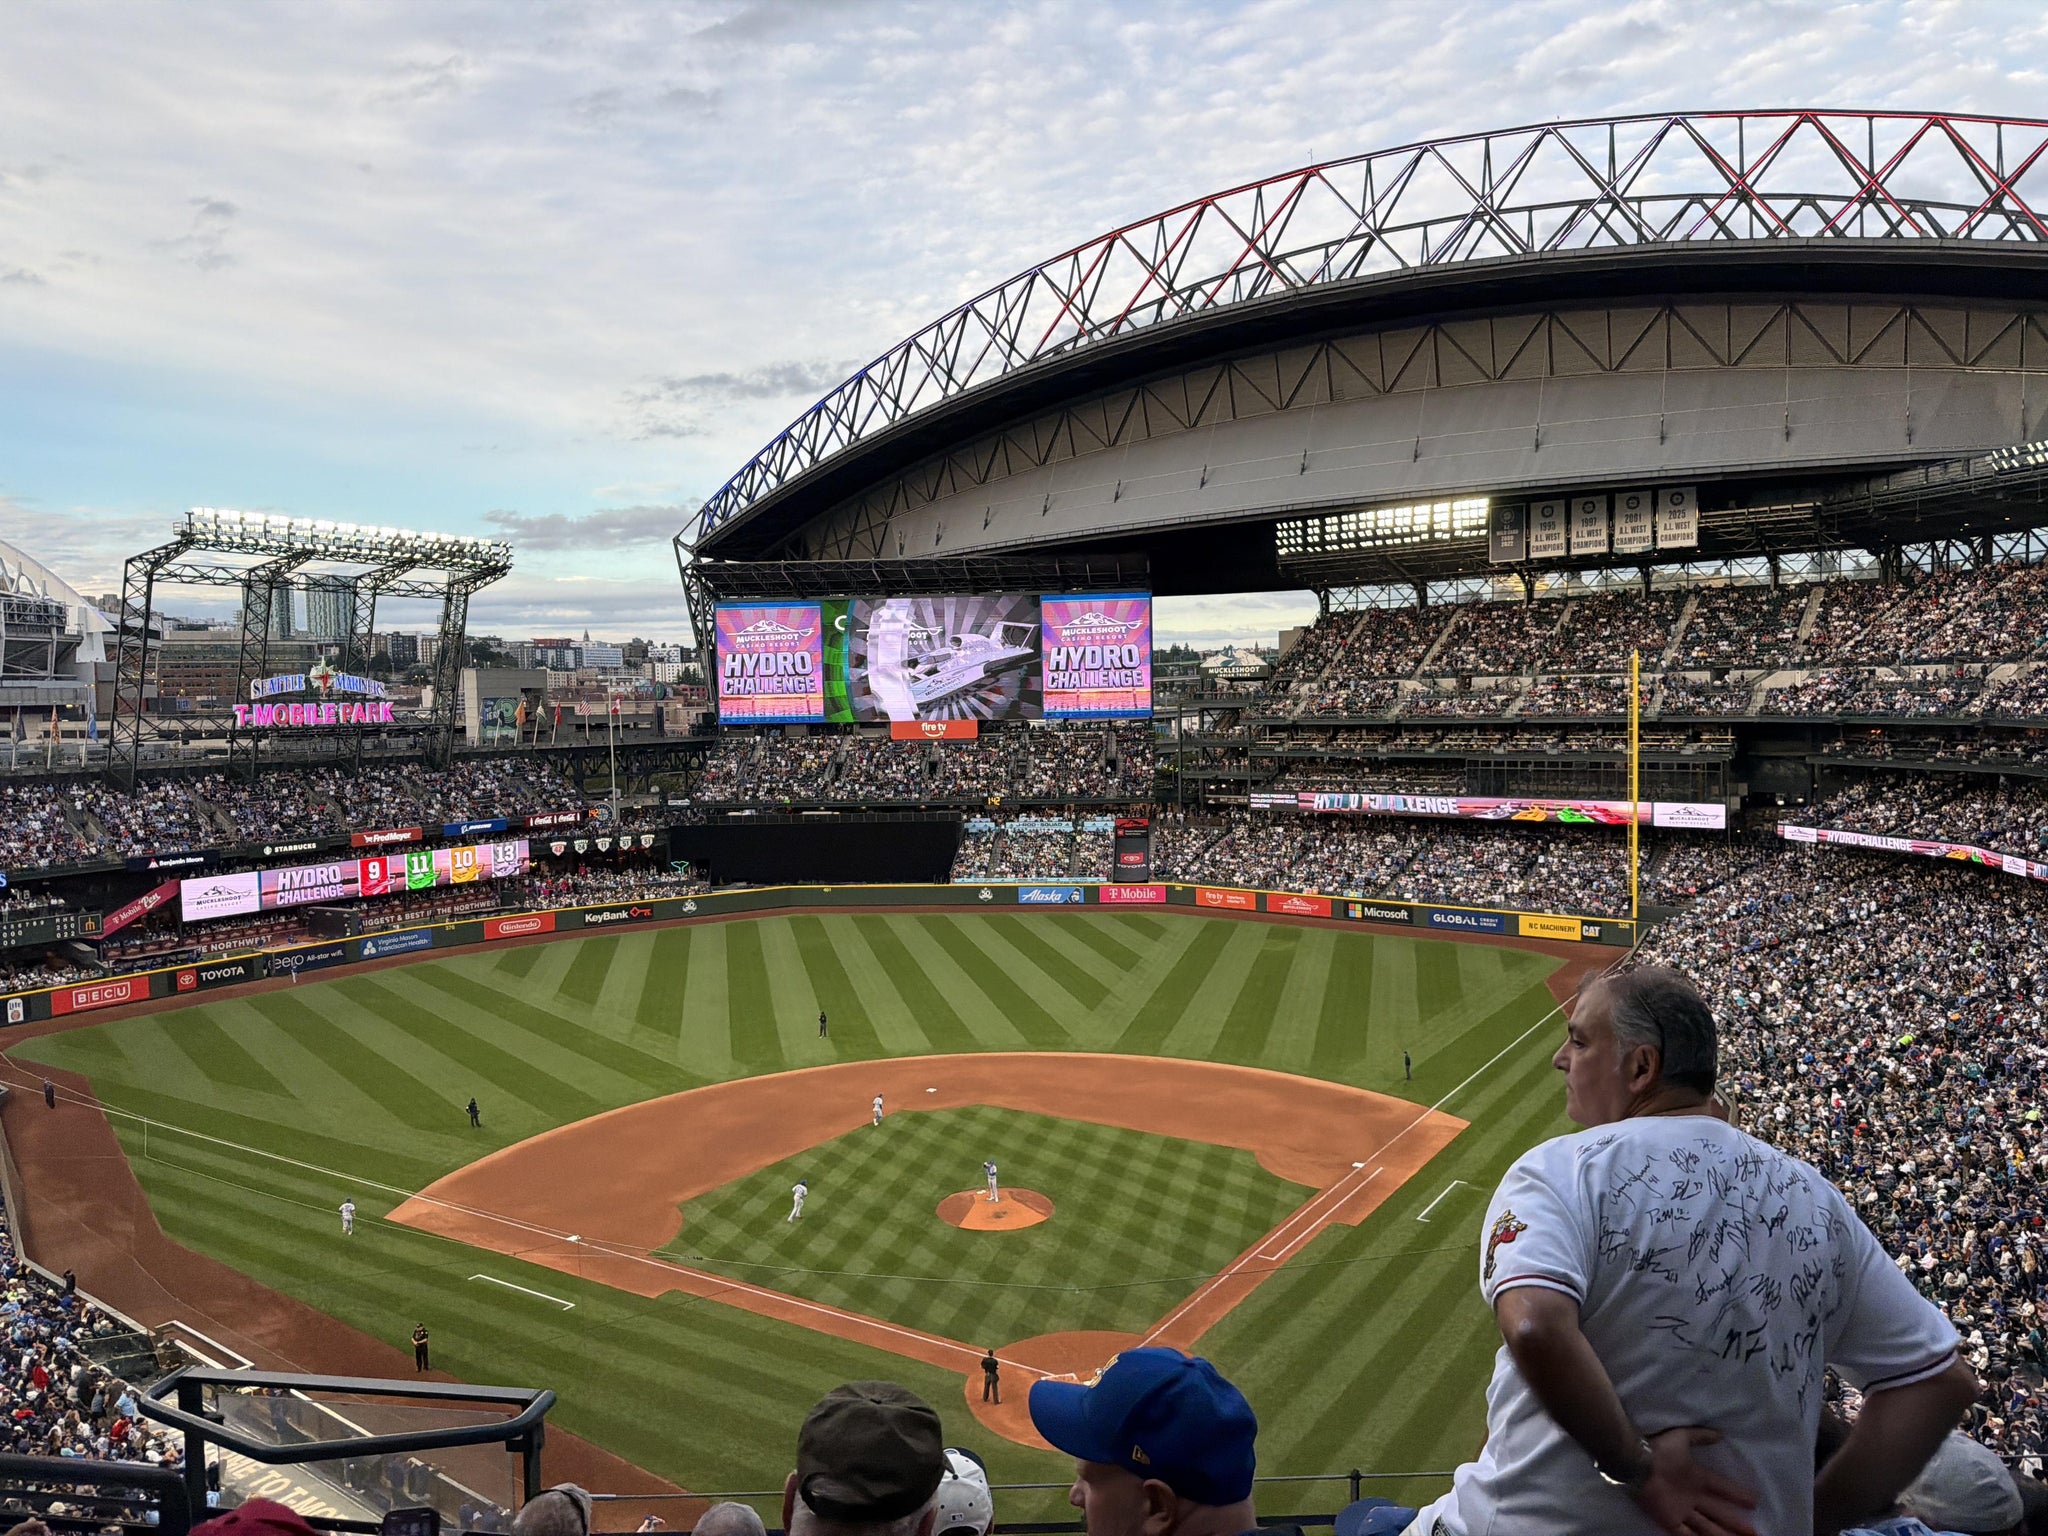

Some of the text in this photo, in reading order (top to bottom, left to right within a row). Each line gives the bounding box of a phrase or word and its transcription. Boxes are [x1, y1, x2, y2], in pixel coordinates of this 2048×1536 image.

[1624, 513, 1641, 523] 2001
[1668, 510, 1686, 519] 2025
[1581, 518, 1597, 527] 1997
[1630, 525, 1647, 533] WEST
[1675, 521, 1690, 530] WEST
[1545, 533, 1560, 541] WEST
[1587, 529, 1602, 537] WEST
[1660, 532, 1694, 542] CHAMPIONS
[1573, 539, 1605, 549] CHAMPIONS
[1616, 535, 1650, 546] CHAMPIONS
[1531, 543, 1563, 552] CHAMPIONS
[1062, 626, 1126, 636] MUCKLESHOOT
[736, 633, 799, 643] MUCKLESHOOT
[1049, 643, 1141, 671] HYDRO
[724, 651, 813, 678] HYDRO
[1208, 666, 1260, 674] MUCKLESHOOT
[253, 673, 386, 698] SEATTLE MARINERS
[1047, 669, 1144, 689] CHALLENGE
[723, 677, 817, 695] CHALLENGE
[233, 701, 395, 726] T-MOBILE PARK
[921, 722, 947, 731] fire tv
[274, 842, 317, 853] STARBUCKS
[1827, 831, 1912, 851] HYDRO CHALLENGE
[454, 851, 472, 868] 10
[496, 845, 514, 862] 13
[159, 858, 185, 866] Benjamin
[411, 856, 429, 873] 11
[368, 861, 380, 879] 9
[277, 865, 342, 891] HYDRO
[276, 883, 345, 905] CHALLENGE
[1022, 888, 1062, 901] Alaska
[1120, 888, 1156, 899] Mobile
[119, 904, 142, 921] Mobile
[139, 892, 162, 909] Pen
[196, 895, 242, 906] MUCKLESHOOT
[585, 910, 629, 923] KeyBank
[1364, 907, 1409, 920] Microsoft
[1433, 913, 1478, 926] GLOBAL
[502, 921, 537, 931] Nintendo
[1528, 922, 1576, 933] NC MACHINERY
[1582, 925, 1601, 937] CAT
[378, 933, 418, 946] Virginia Mason
[379, 939, 428, 952] Franciscan Health
[273, 954, 304, 969] eero
[307, 953, 329, 962] All-star
[201, 966, 245, 981] TOYOTA
[78, 986, 126, 1003] BECU
[9, 1001, 21, 1010] Lite
[249, 1469, 292, 1496] TO
